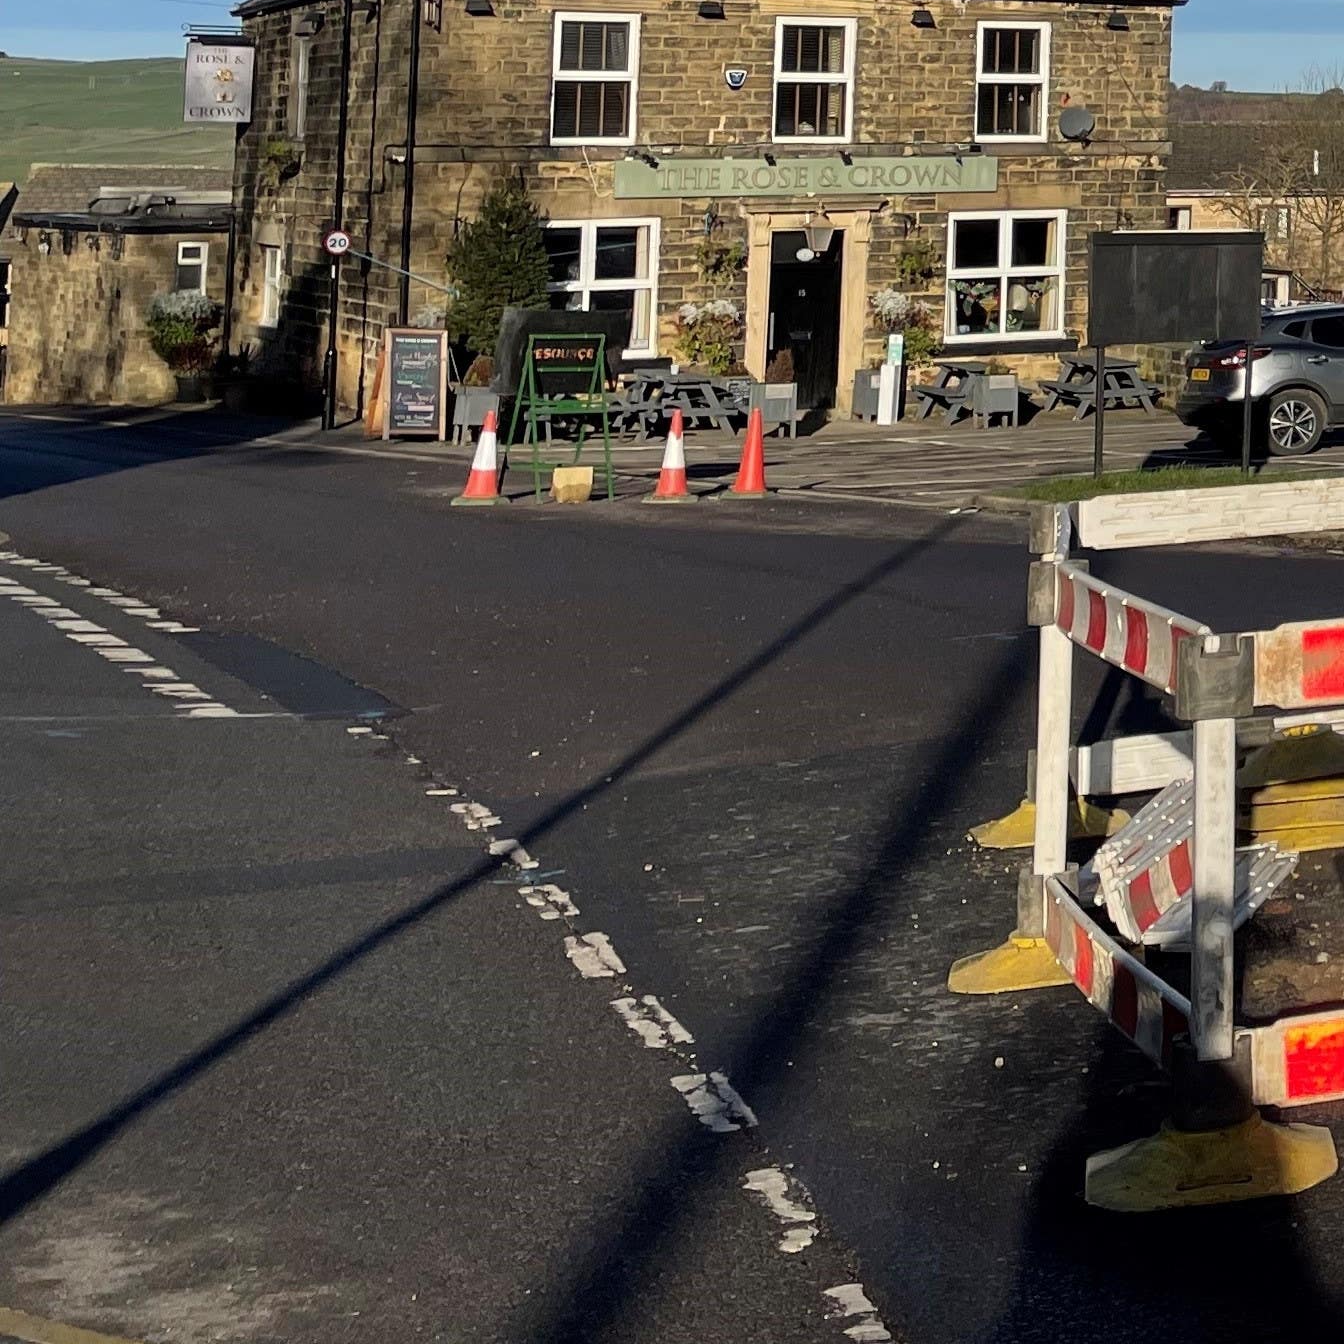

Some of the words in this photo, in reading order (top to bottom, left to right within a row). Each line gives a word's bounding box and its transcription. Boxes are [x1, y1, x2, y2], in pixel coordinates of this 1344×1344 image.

[196, 54, 230, 64] ROSE
[234, 55, 245, 64] &
[189, 107, 245, 117] CROWN
[656, 166, 721, 191] THE
[732, 165, 809, 190] ROSE
[819, 165, 842, 188] &
[848, 164, 963, 188] CROWN
[329, 238, 347, 248] 20
